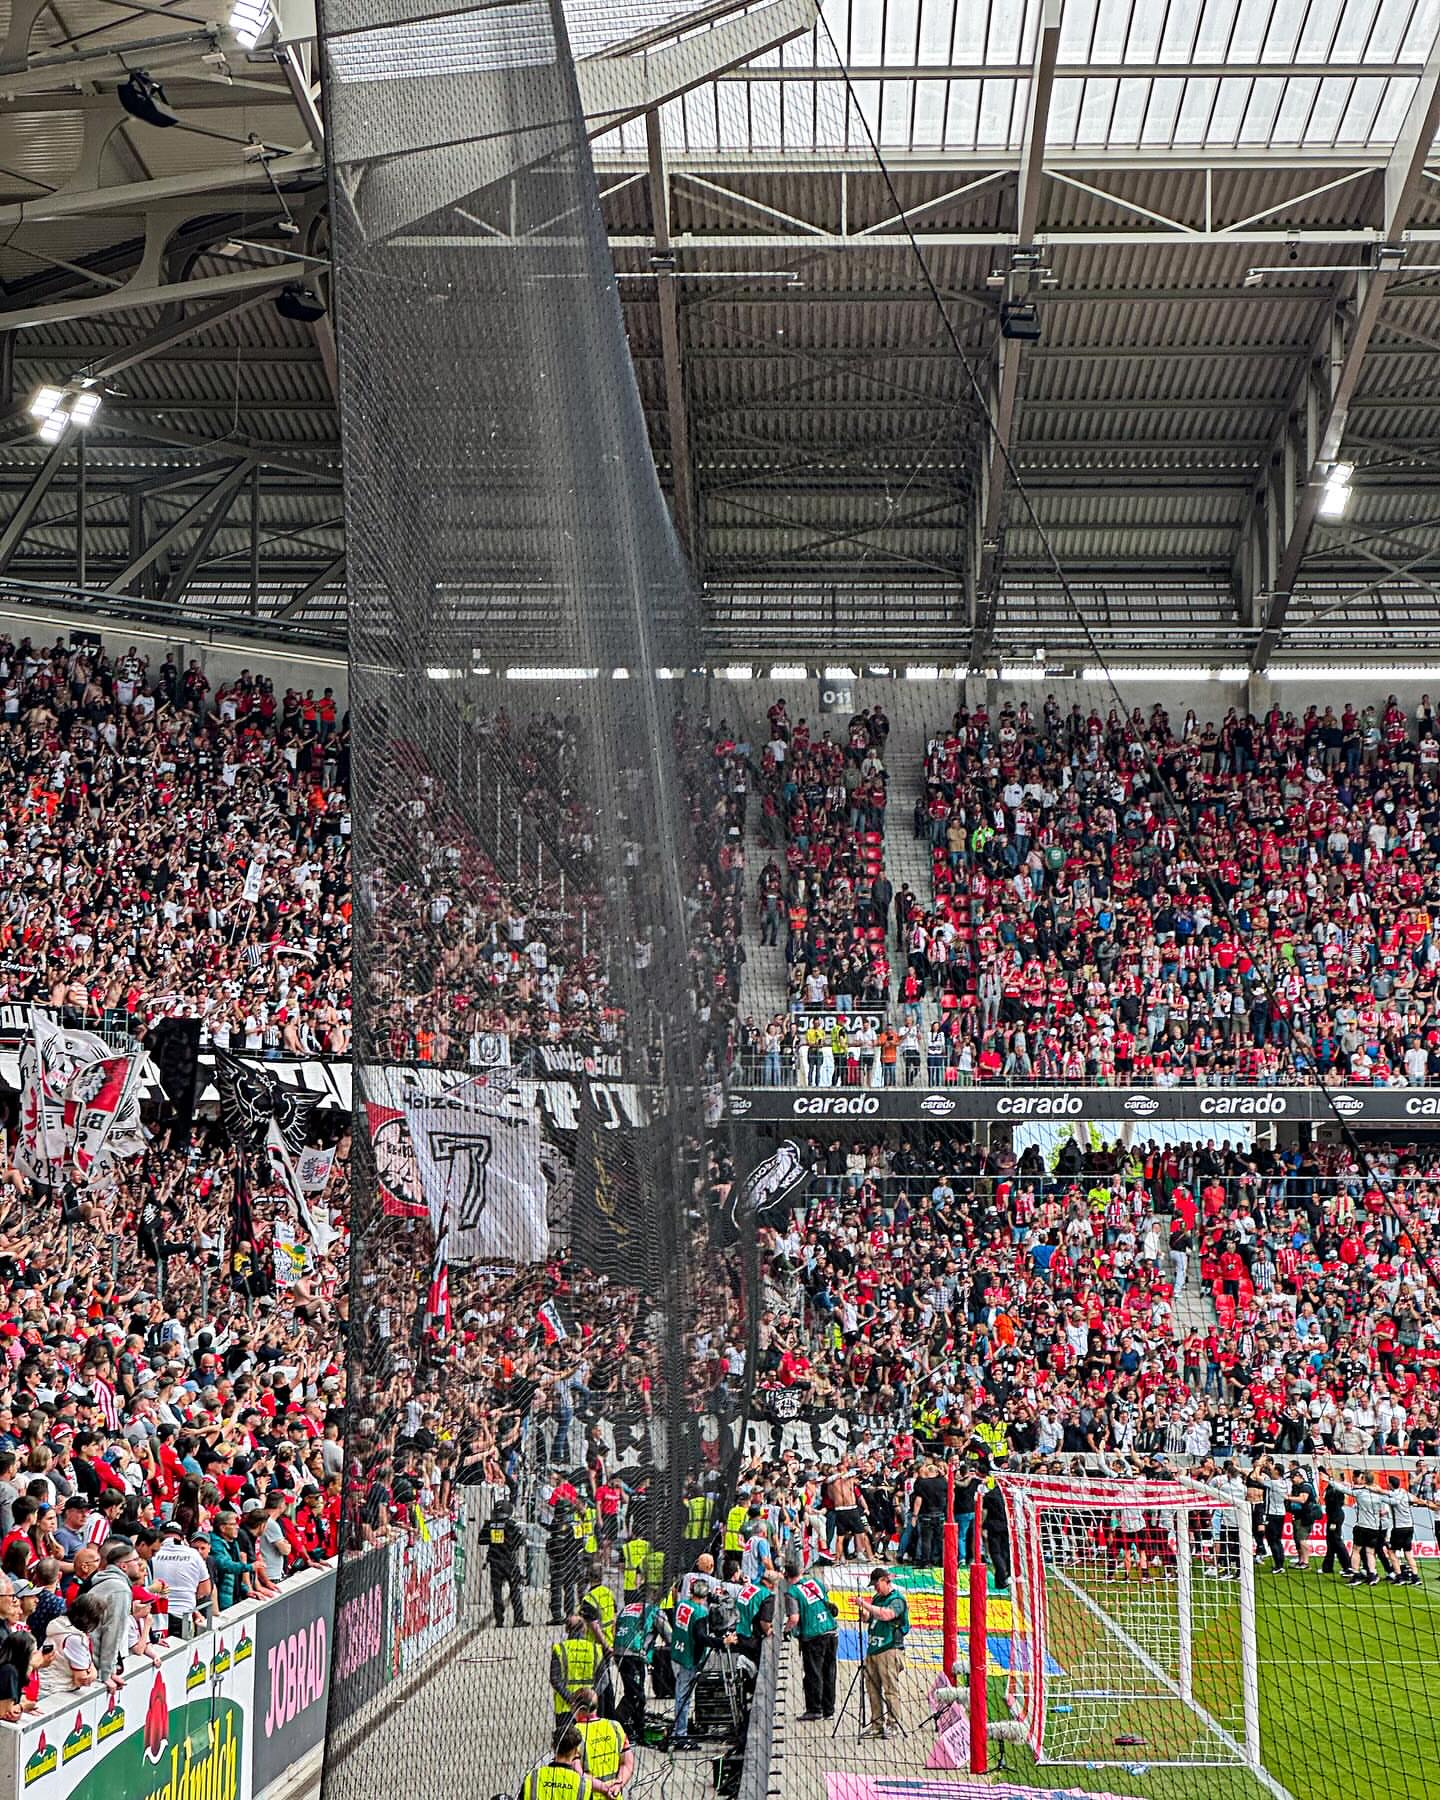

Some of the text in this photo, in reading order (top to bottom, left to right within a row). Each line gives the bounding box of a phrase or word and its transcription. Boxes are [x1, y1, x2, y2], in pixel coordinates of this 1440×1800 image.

[798, 1016, 880, 1031] JOBRAD
[793, 1094, 879, 1114] carado
[921, 1100, 955, 1109] carado
[996, 1094, 1083, 1114] carado
[1124, 1100, 1159, 1109] carado
[1200, 1093, 1286, 1114] carado
[265, 1616, 326, 1739] JOBRAD
